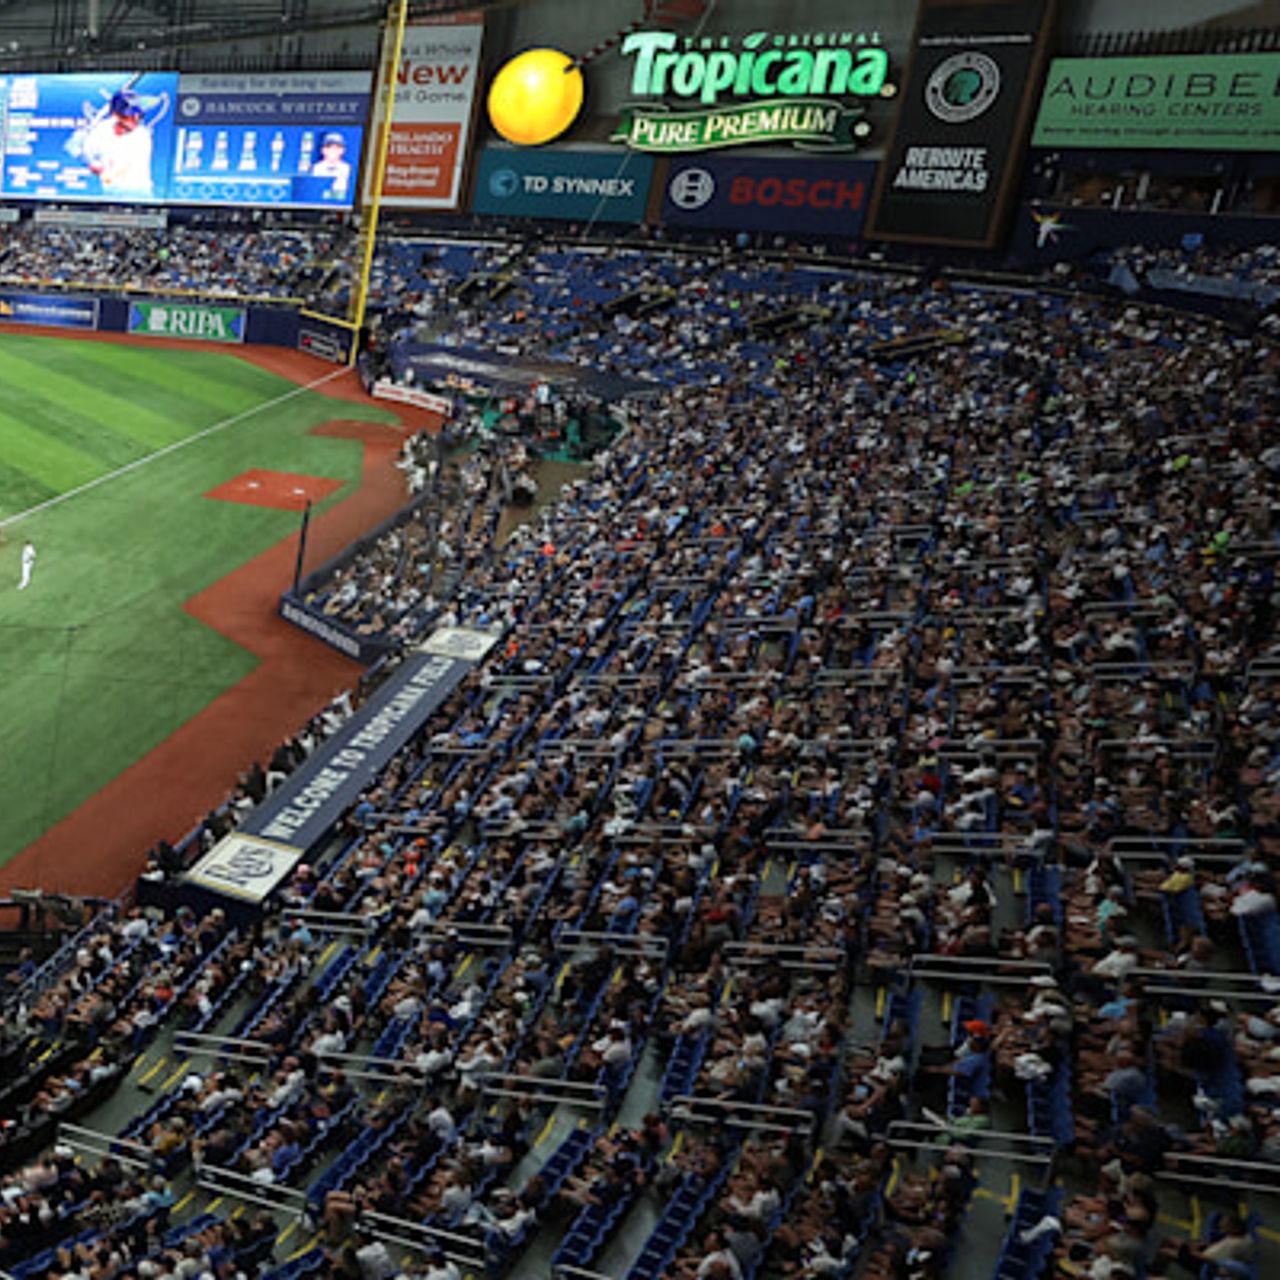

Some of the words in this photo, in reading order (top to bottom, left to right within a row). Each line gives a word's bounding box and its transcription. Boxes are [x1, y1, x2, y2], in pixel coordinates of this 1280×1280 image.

[384, 57, 470, 85] New
[620, 31, 890, 104] Tropicana
[1049, 71, 1280, 99] AUDIBE
[204, 101, 276, 114] HANCOCK
[280, 101, 360, 114] WHITNEY
[1071, 102, 1157, 116] HEARING
[1167, 102, 1264, 117] CENTERS
[631, 116, 702, 143] PURE
[703, 105, 837, 141] PREMIUM
[905, 146, 988, 170] REROUTE
[522, 174, 548, 192] TD
[553, 175, 635, 197] SYNNEX
[728, 176, 865, 210] BOSCH
[892, 167, 989, 192] AMERICAS
[169, 309, 227, 338] RIPA
[412, 655, 457, 689] FIELD
[348, 682, 429, 752] TROPICANA
[337, 748, 368, 770] TO
[259, 767, 349, 840] WELCOME
